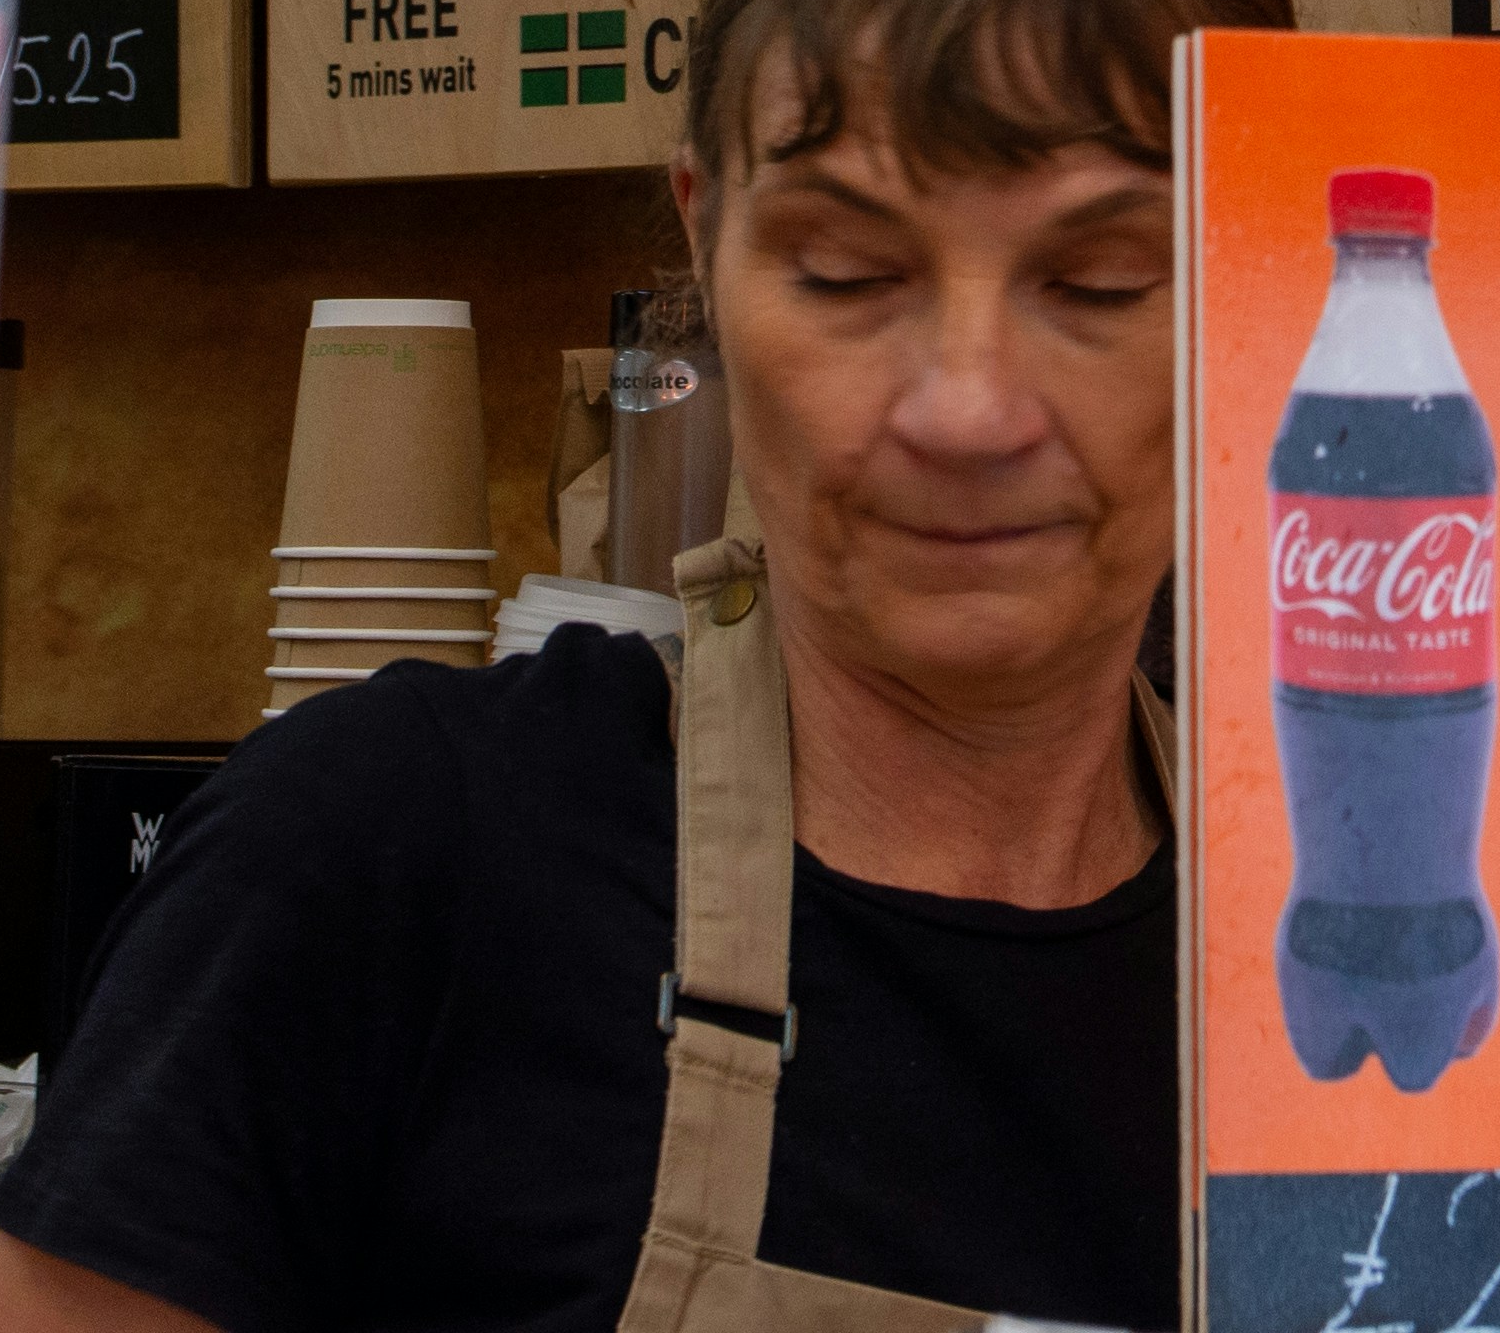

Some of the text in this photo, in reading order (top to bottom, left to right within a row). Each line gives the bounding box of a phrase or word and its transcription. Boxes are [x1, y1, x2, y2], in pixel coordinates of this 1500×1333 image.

[327, 58, 476, 100] 5 mins wait
[1271, 509, 1496, 623] Coca-Cola
